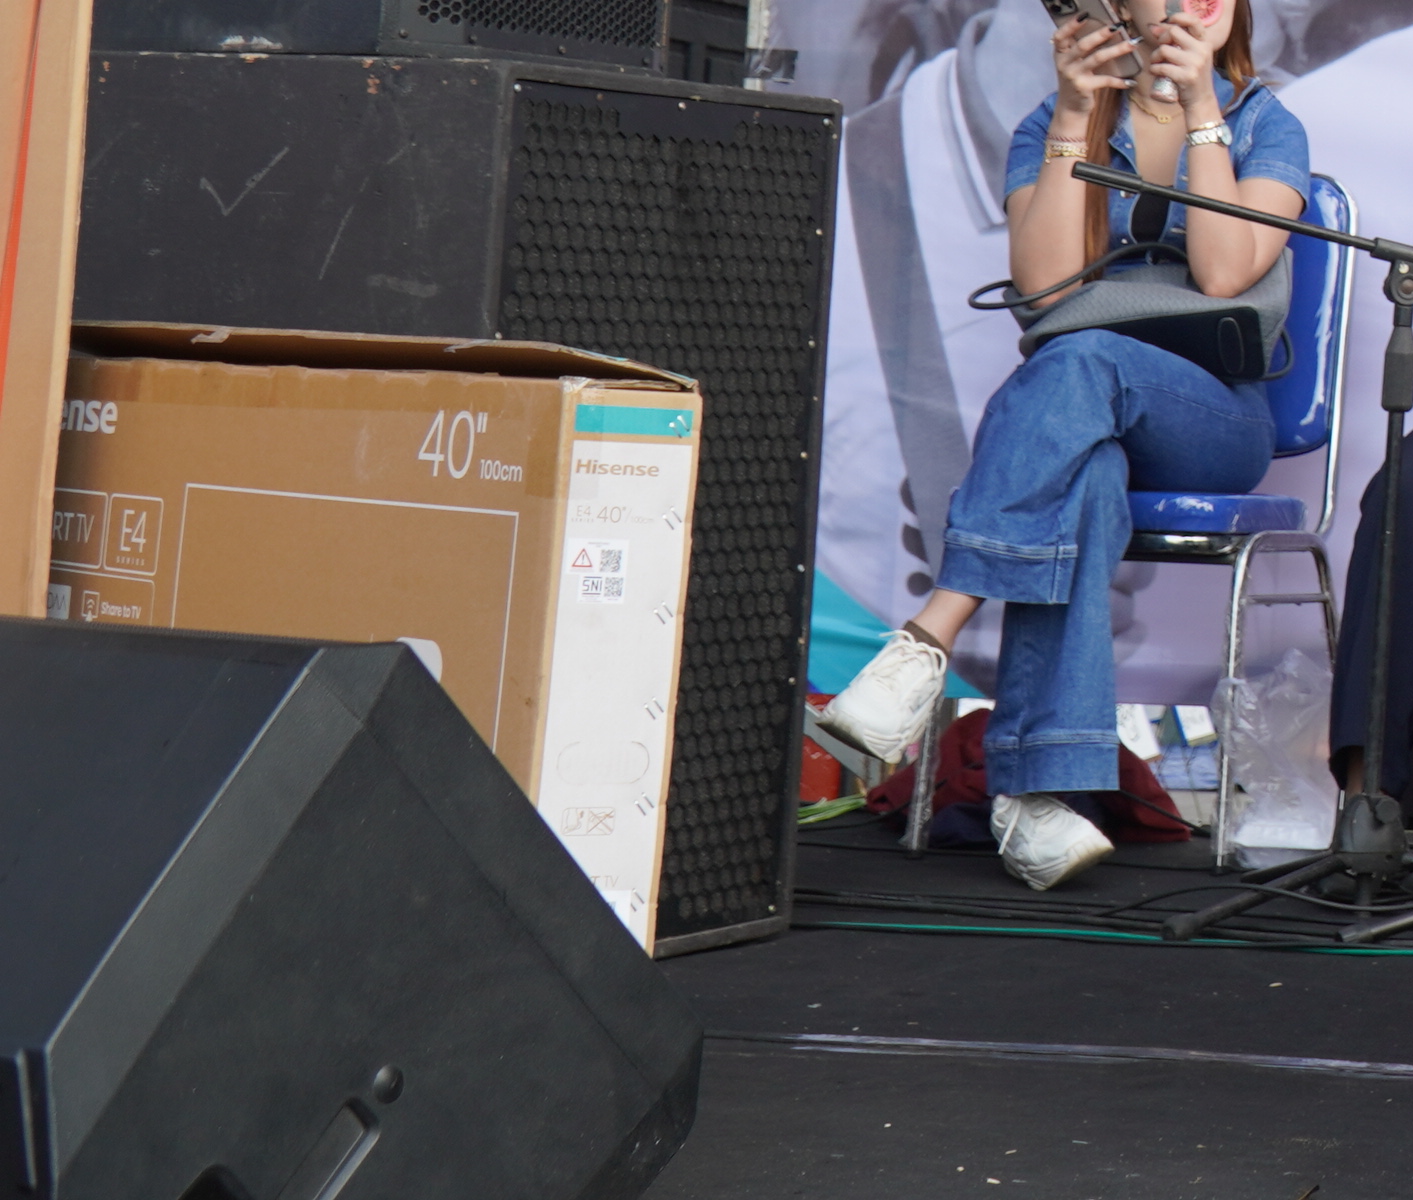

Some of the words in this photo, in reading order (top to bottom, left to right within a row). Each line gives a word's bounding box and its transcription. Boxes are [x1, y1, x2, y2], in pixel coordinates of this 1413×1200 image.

[480, 458, 523, 484] 100cm
[575, 459, 660, 478] Hisense
[119, 509, 147, 553] E4
[582, 579, 602, 593] SNI
[100, 602, 118, 618] Share
[118, 604, 130, 618] to
[129, 604, 142, 620] TV
